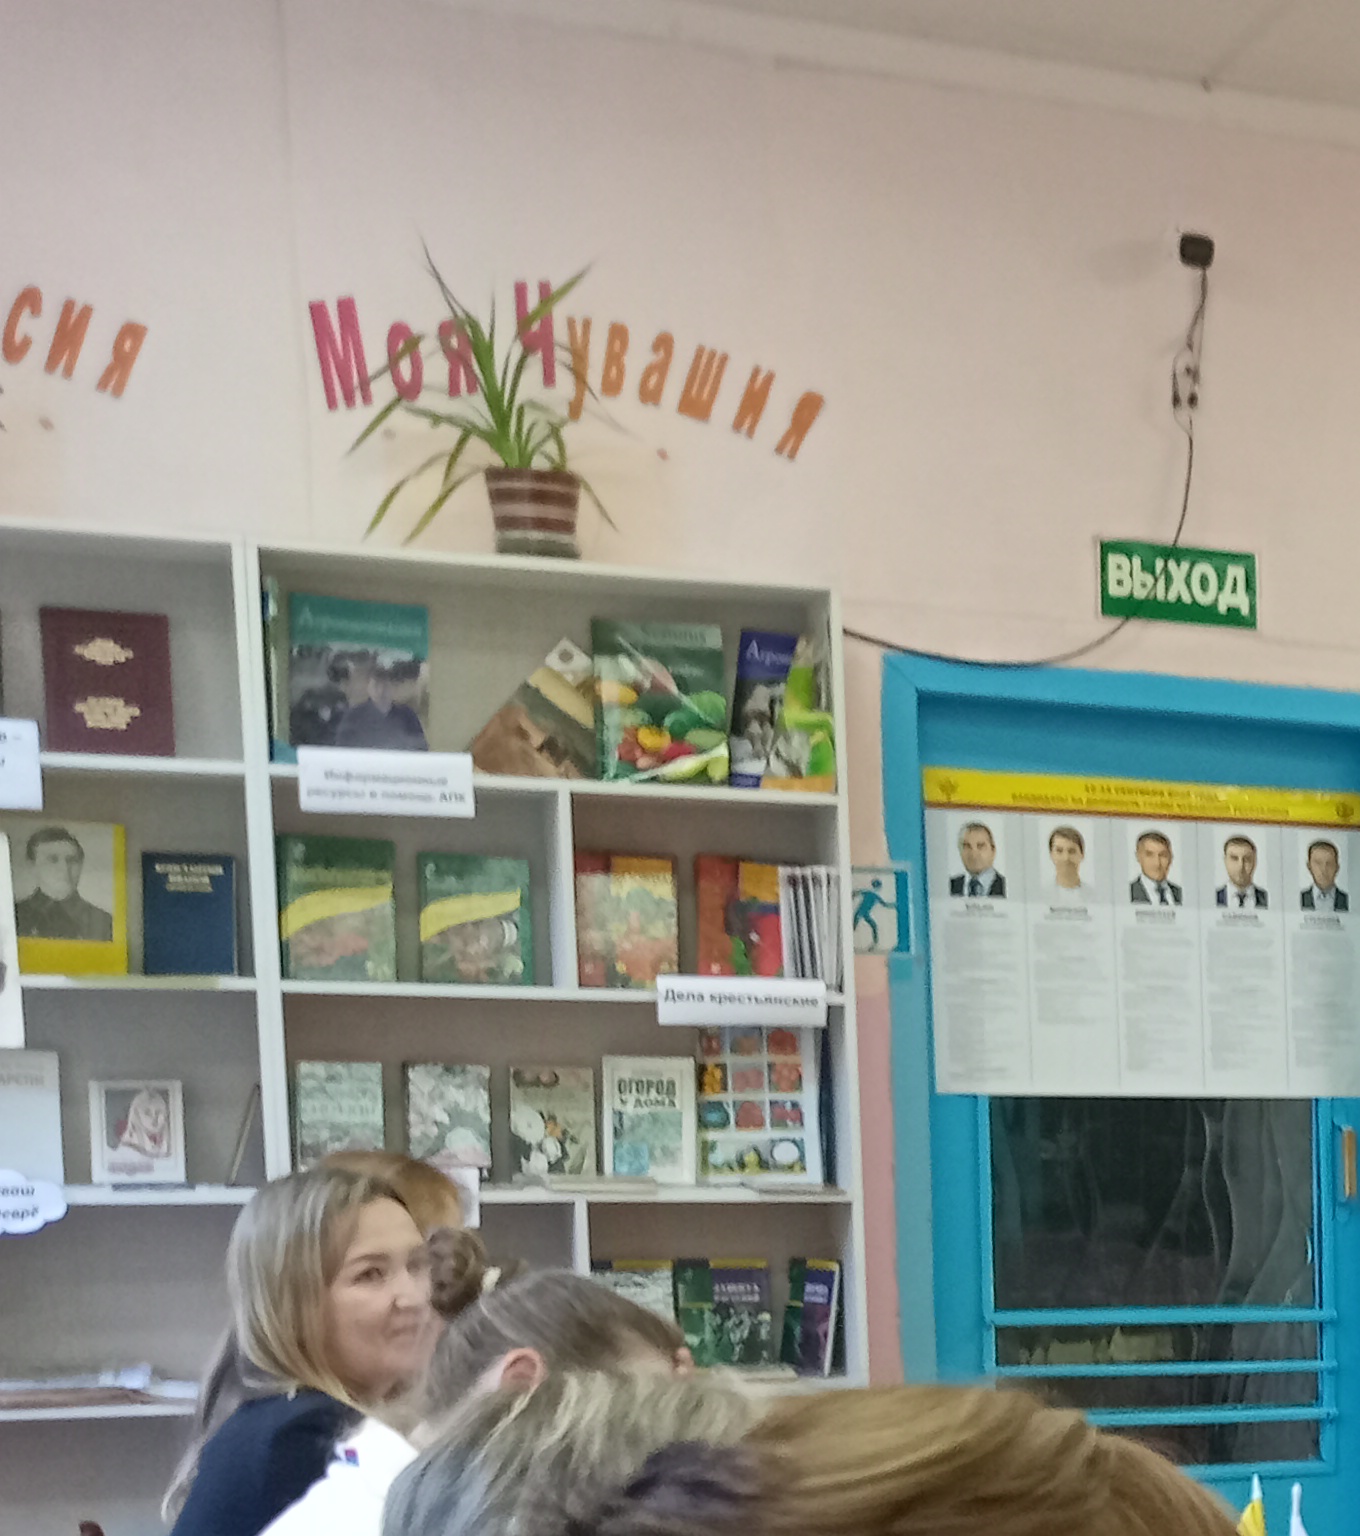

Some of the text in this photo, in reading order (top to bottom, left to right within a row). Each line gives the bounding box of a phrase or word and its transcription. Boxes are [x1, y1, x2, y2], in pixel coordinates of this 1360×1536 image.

[308, 279, 825, 461] Моя Чувашия
[1107, 552, 1251, 617] ВЫХОД
[664, 988, 819, 1009] Дела крестьянские
[618, 1077, 677, 1097] ОГОРОД
